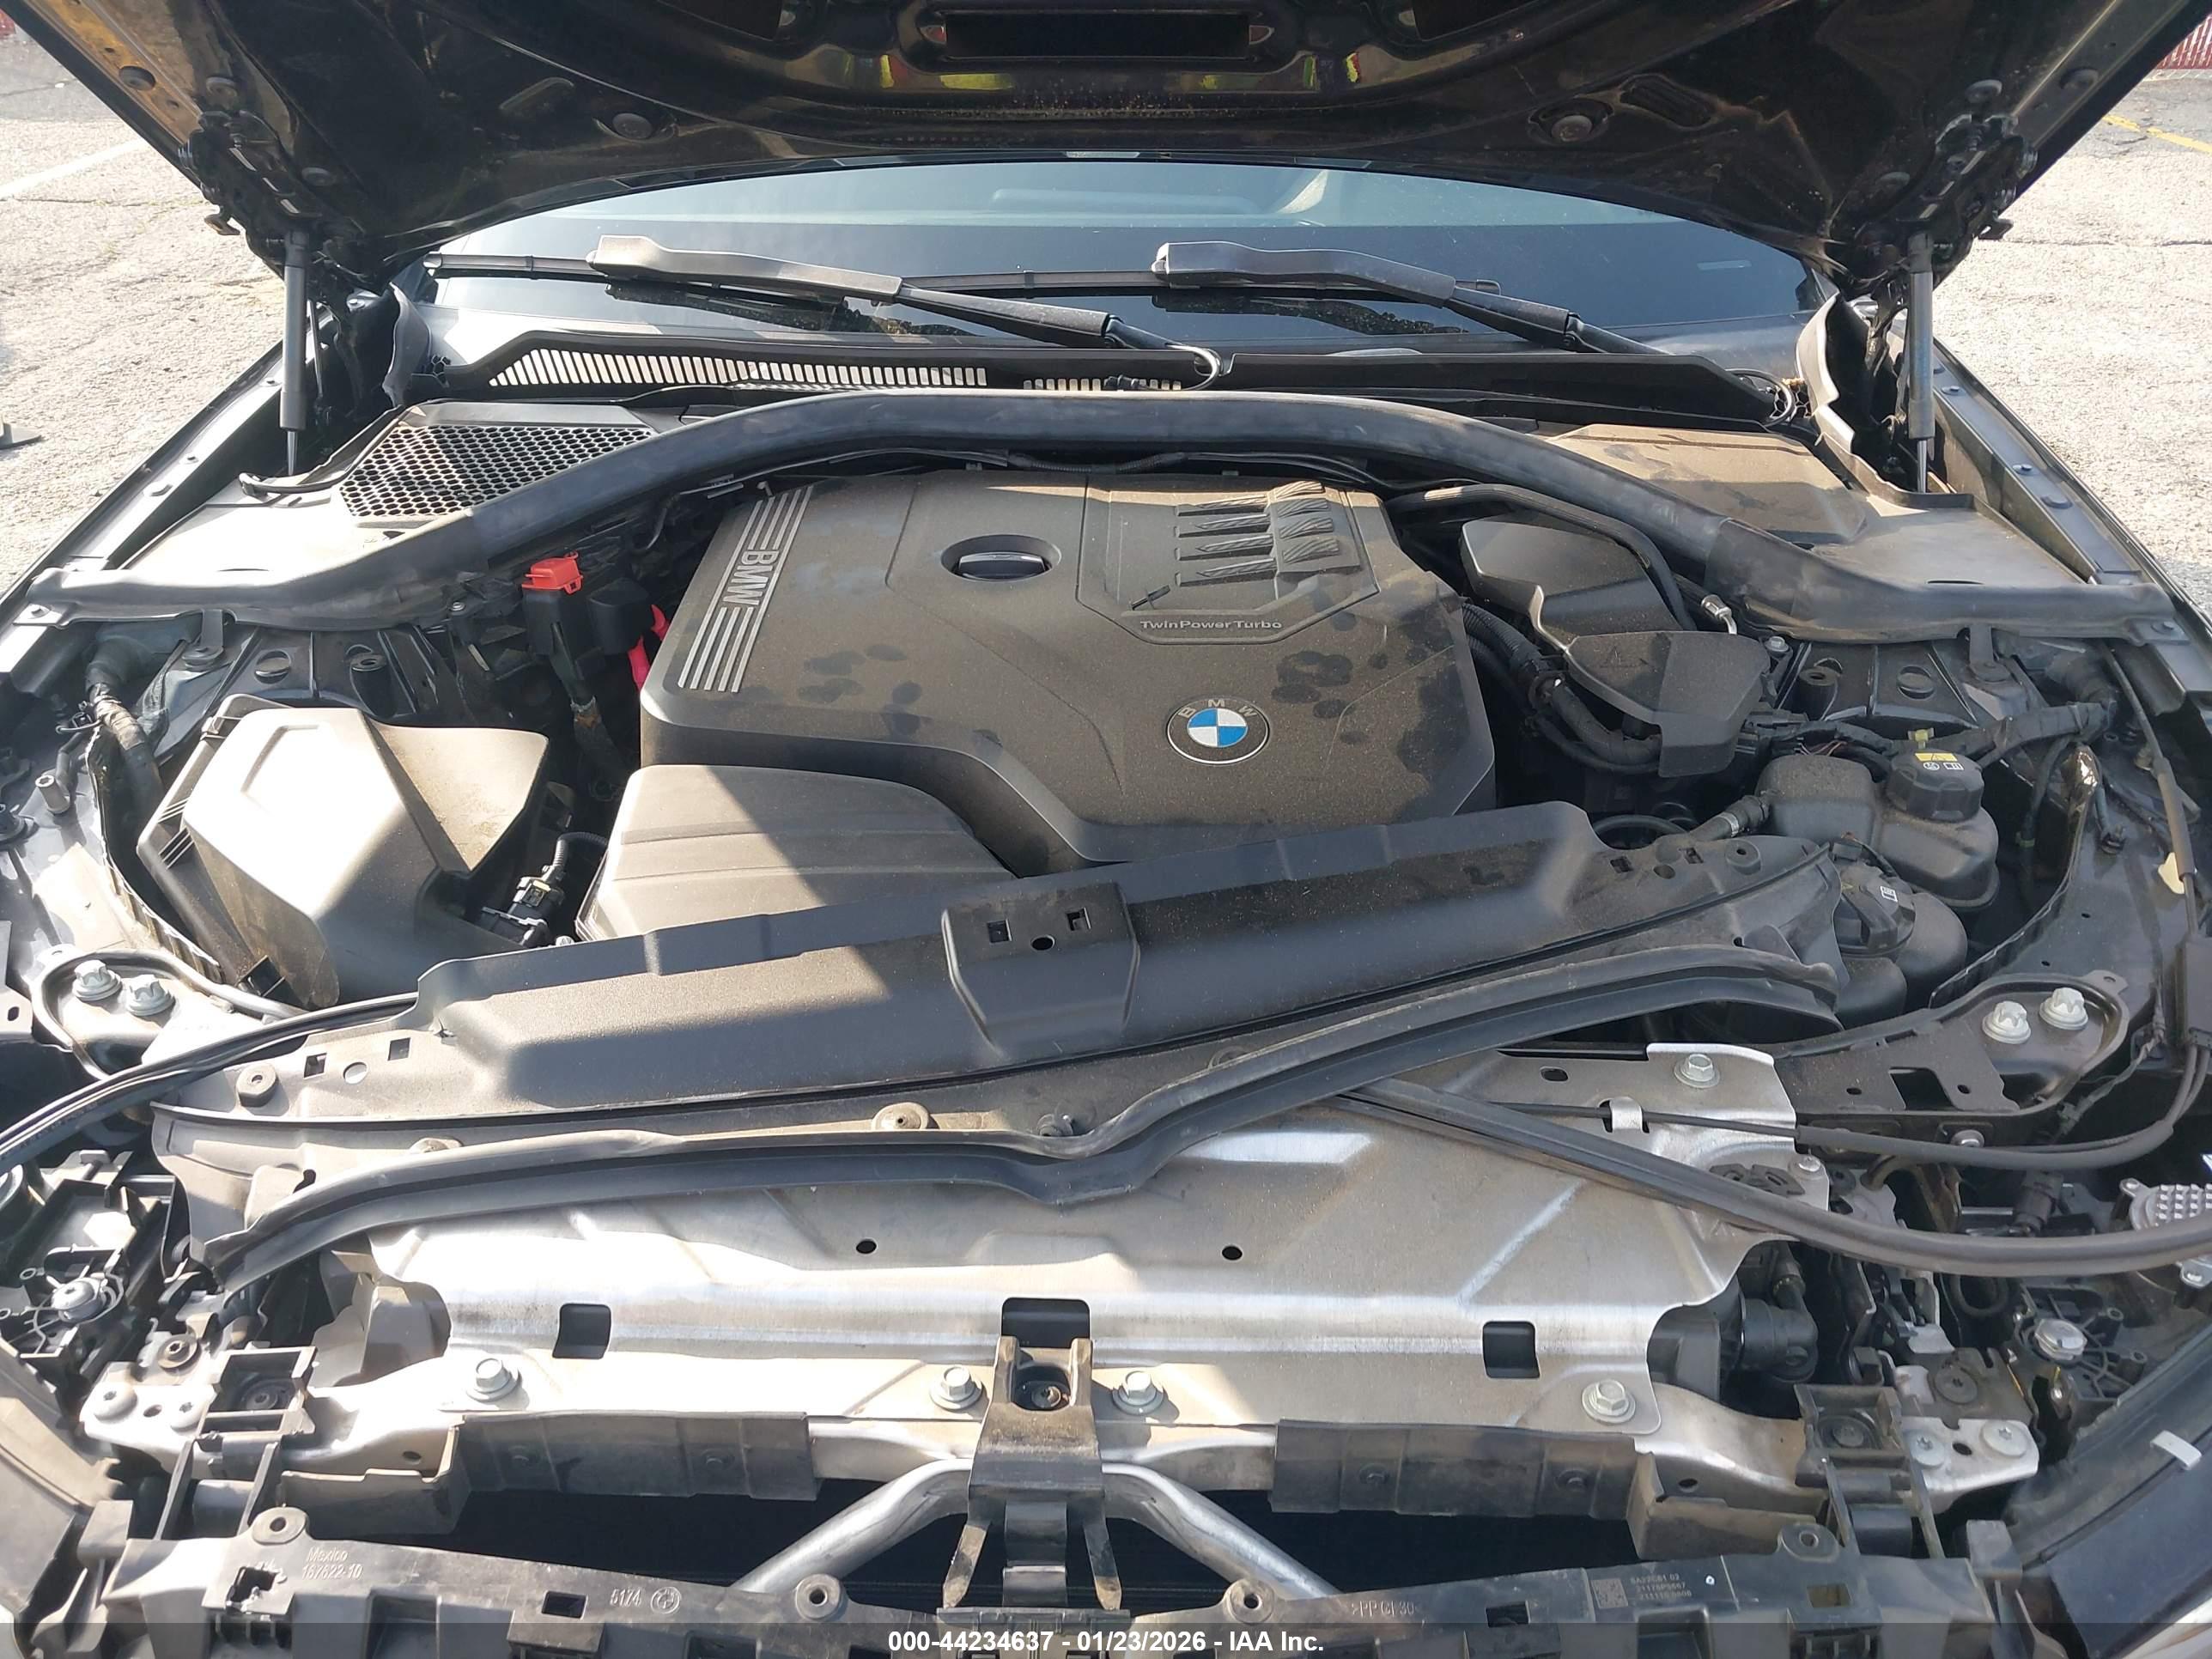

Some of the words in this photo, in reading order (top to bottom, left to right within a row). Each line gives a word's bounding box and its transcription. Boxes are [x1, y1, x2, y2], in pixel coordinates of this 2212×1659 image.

[723, 550, 780, 605] BMW
[1233, 620, 1283, 629] Turbo
[1178, 699, 1257, 718] BMW
[307, 1547, 349, 1563] Mexico
[610, 1589, 641, 1607] 5174
